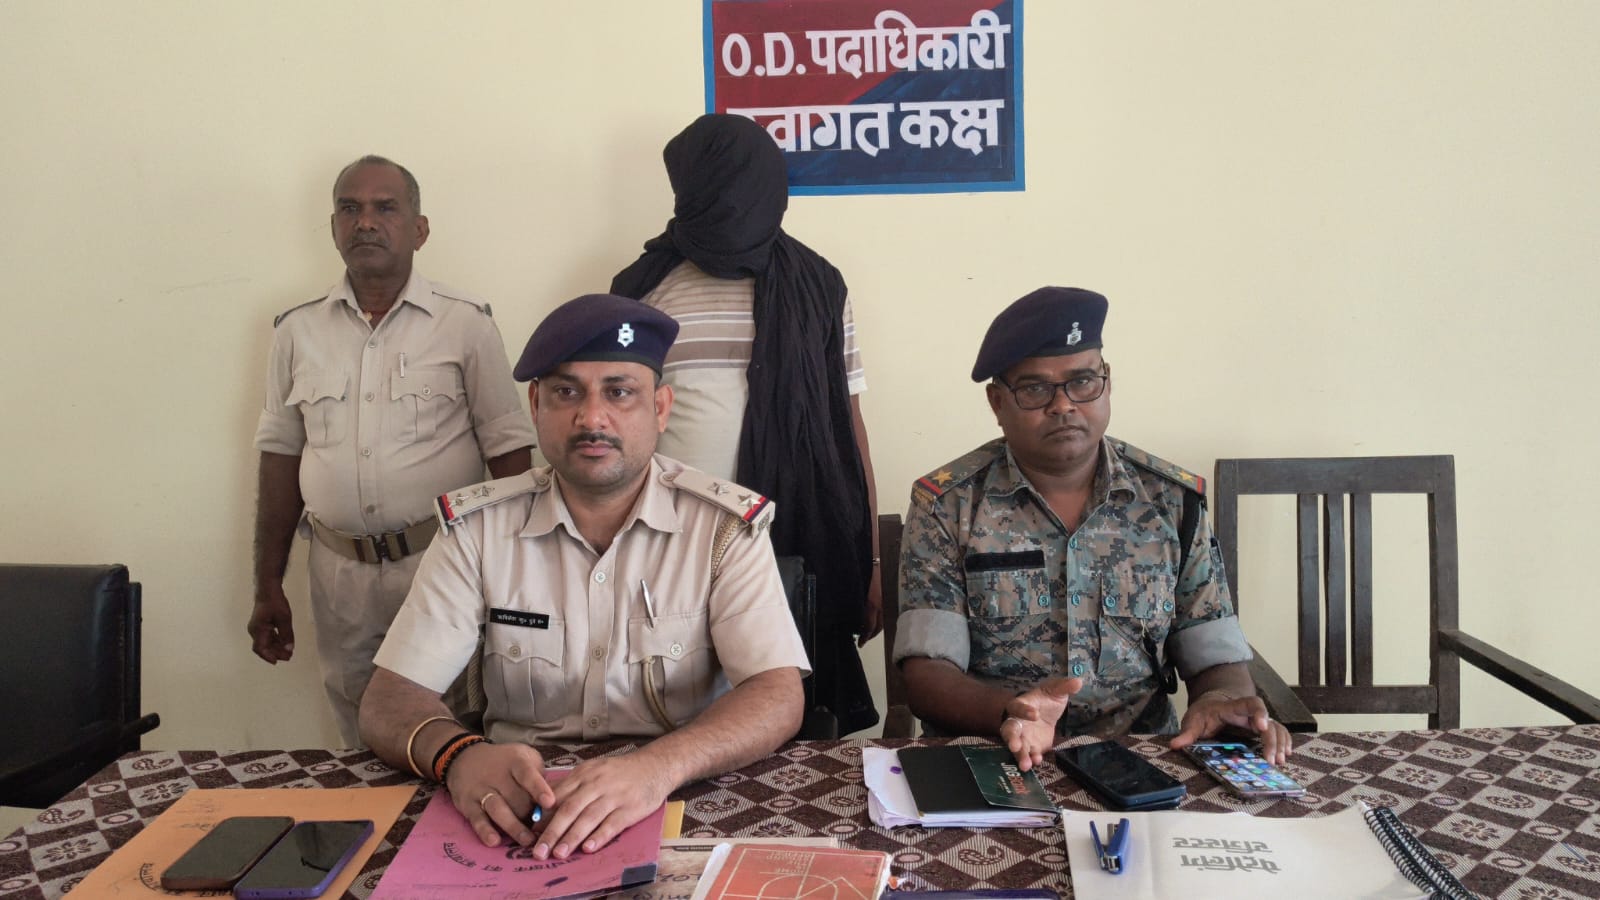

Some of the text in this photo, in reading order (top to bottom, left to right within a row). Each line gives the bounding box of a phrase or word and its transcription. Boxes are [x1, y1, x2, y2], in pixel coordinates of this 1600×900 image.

[722, 9, 1011, 78] O.D. पदाधिकारी
[726, 99, 1005, 157] वागत कक्ष
